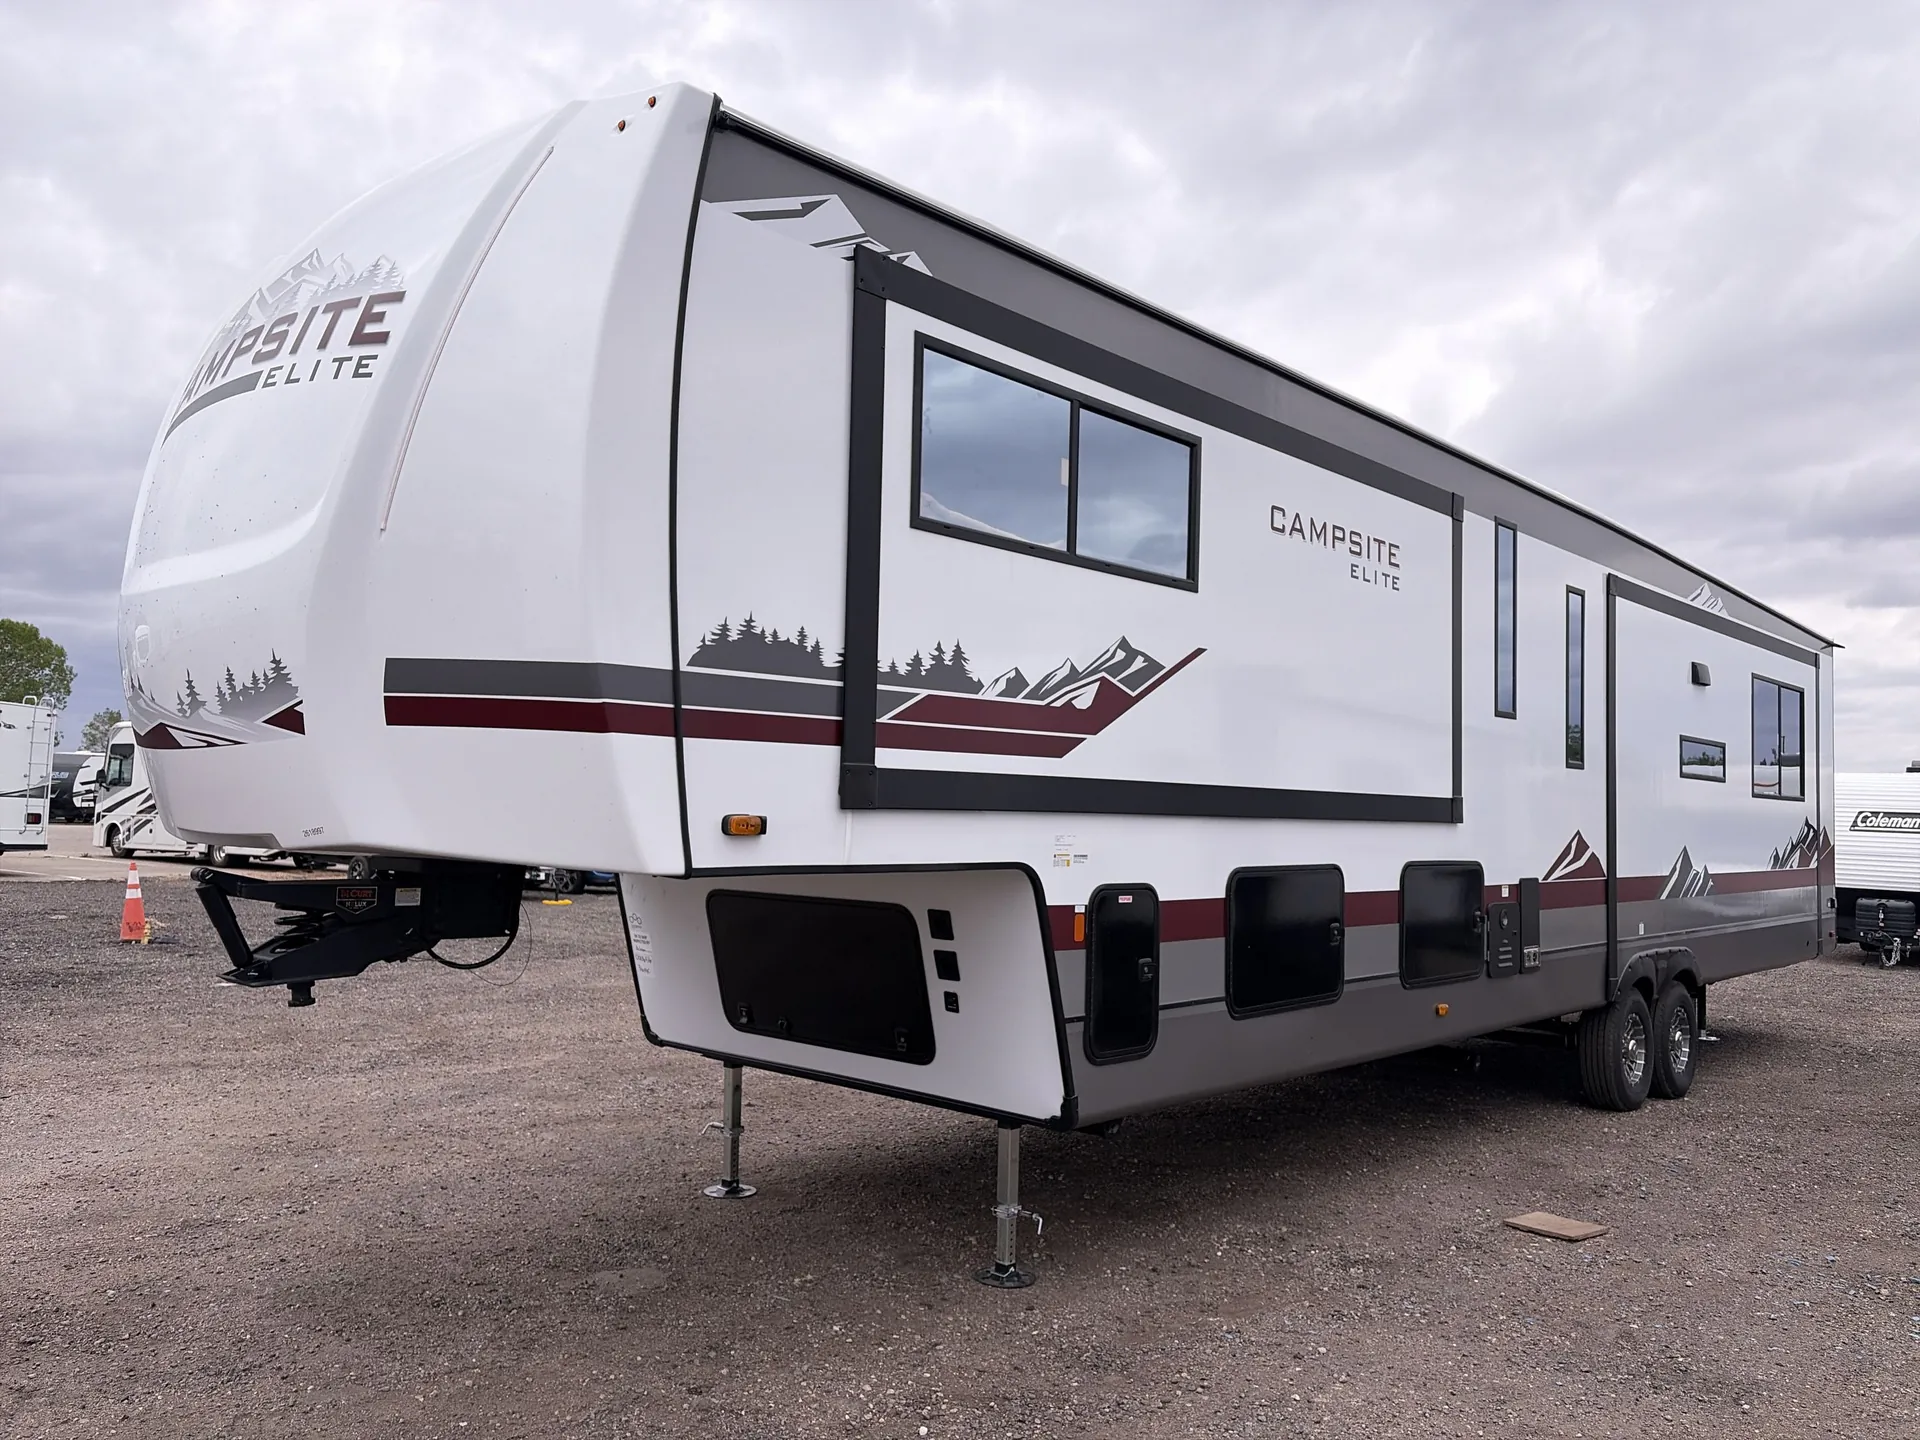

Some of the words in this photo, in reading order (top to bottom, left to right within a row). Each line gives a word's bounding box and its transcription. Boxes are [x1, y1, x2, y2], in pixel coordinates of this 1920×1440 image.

[261, 354, 379, 389] ELITE
[1270, 504, 1400, 568] CAMPSITE
[1350, 562, 1400, 591] ELITE
[1856, 812, 1920, 829] Coleman
